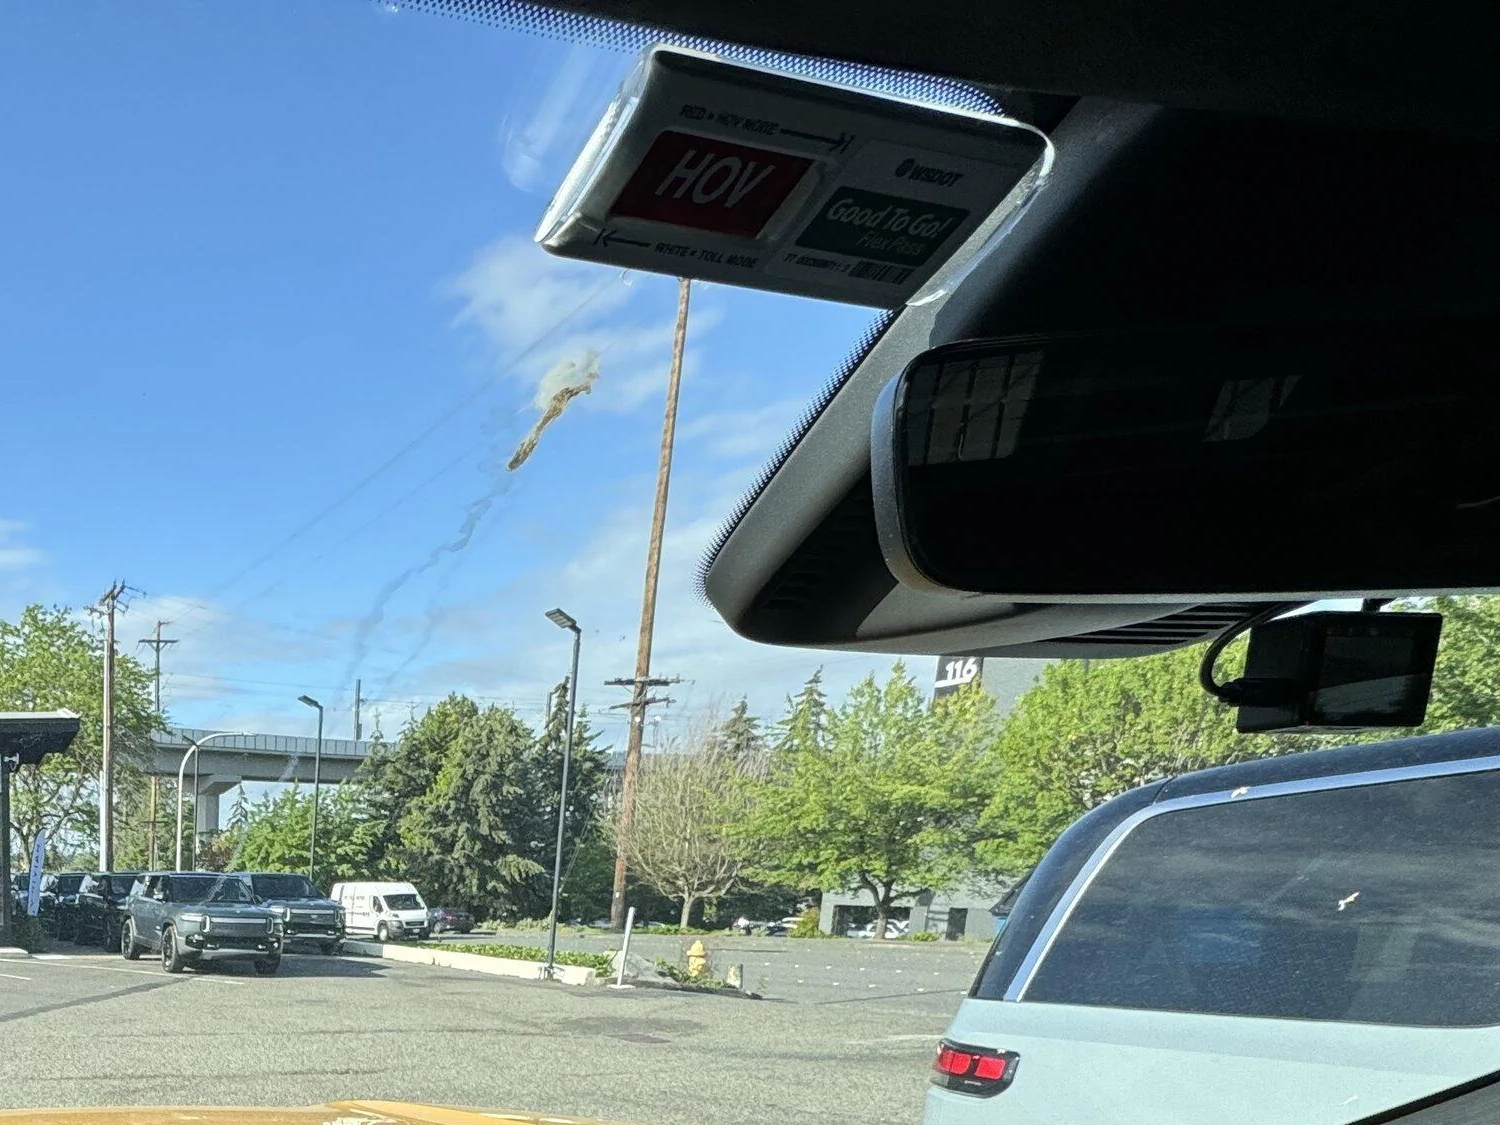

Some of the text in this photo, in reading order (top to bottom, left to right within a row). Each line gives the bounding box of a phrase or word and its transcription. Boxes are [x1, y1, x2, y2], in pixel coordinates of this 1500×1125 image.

[655, 149, 776, 209] HOV
[826, 198, 953, 239] Good To Go!
[655, 242, 690, 257] WHITE
[698, 249, 725, 264] TOLL
[726, 254, 758, 269] MODE
[945, 656, 978, 683] 116
